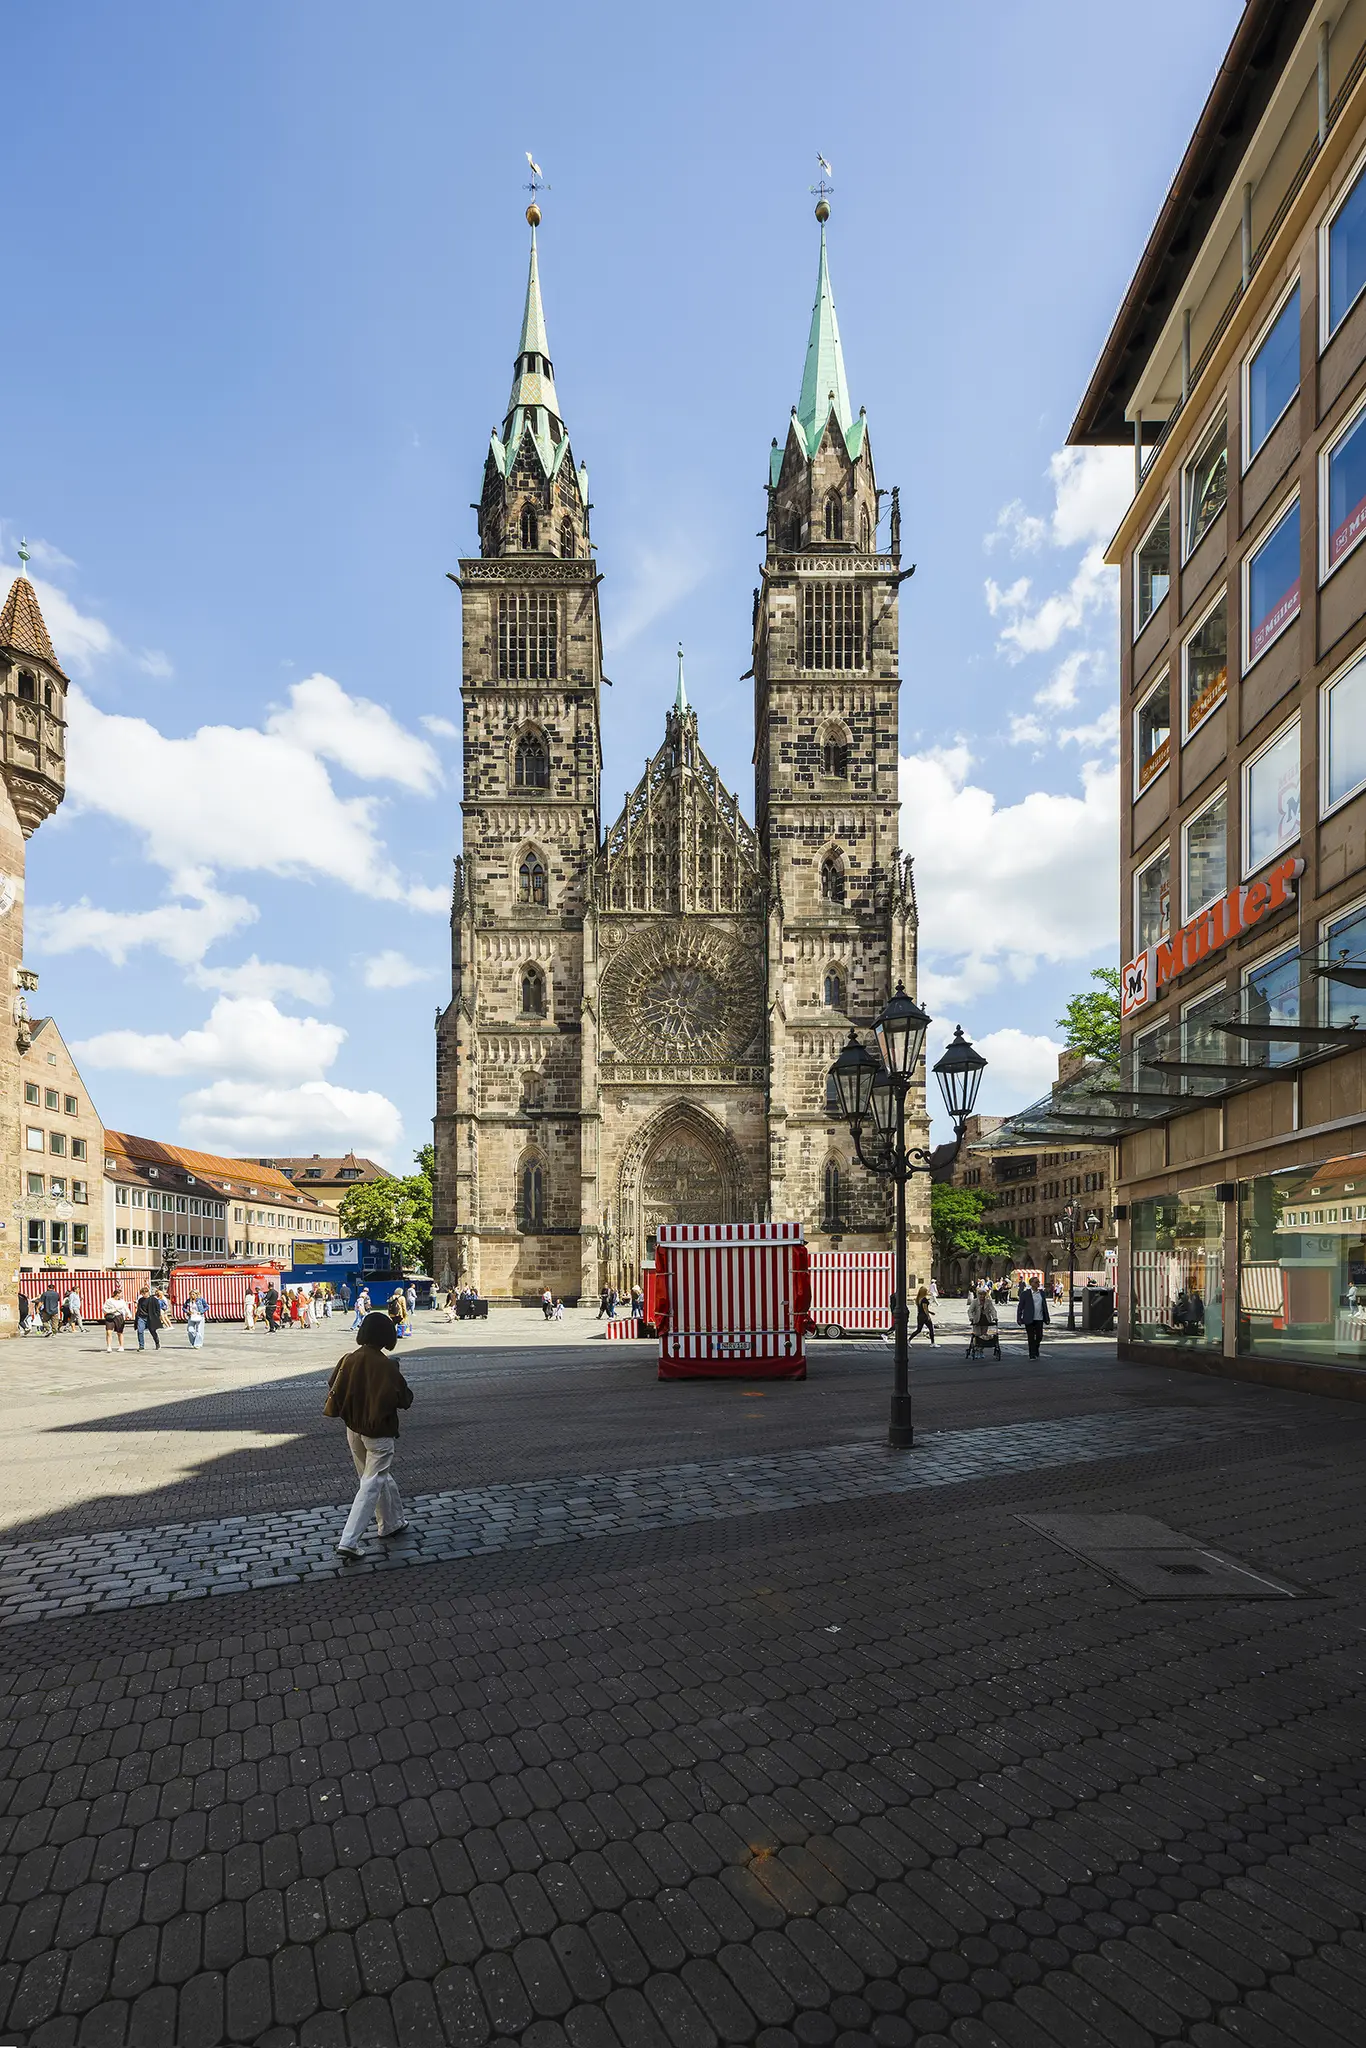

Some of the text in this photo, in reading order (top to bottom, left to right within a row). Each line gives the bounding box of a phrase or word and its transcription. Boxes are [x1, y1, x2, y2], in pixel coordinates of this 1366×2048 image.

[1265, 591, 1299, 636] Müller
[1200, 677, 1227, 712] Müller
[1149, 746, 1170, 771] Müller
[1128, 857, 1298, 998] M Müller
[330, 1243, 342, 1255] U
